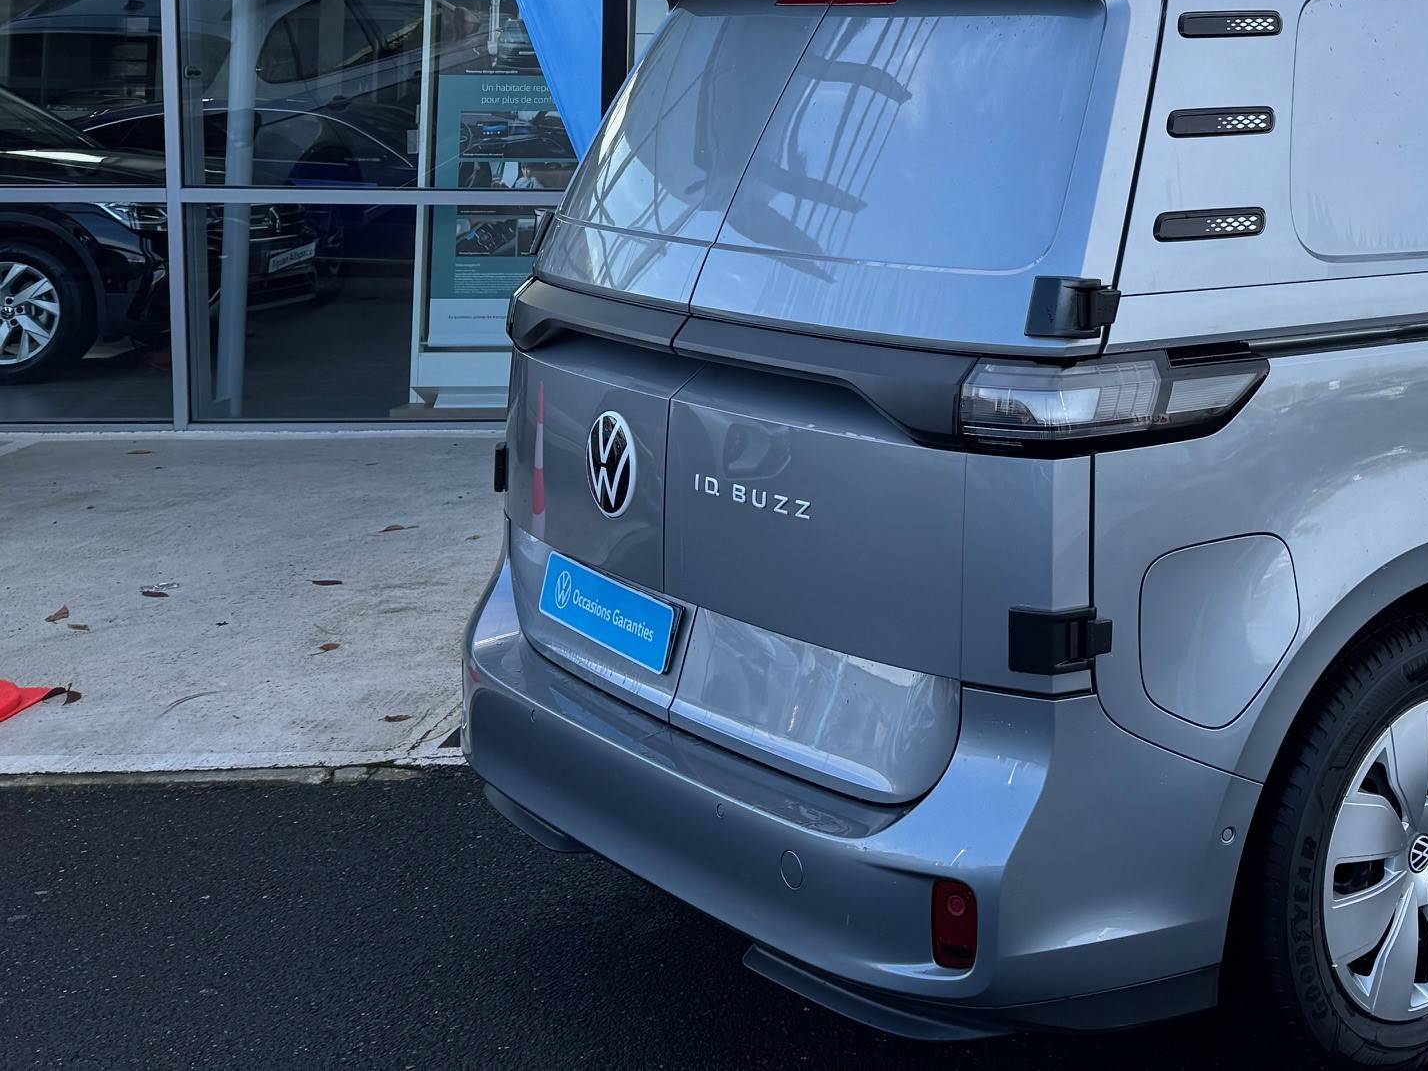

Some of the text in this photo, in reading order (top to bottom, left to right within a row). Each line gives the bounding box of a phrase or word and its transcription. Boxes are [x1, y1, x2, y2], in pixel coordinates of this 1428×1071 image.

[732, 483, 811, 520] BUZZ
[572, 588, 612, 622] Occasions
[612, 608, 654, 642] Garanties
